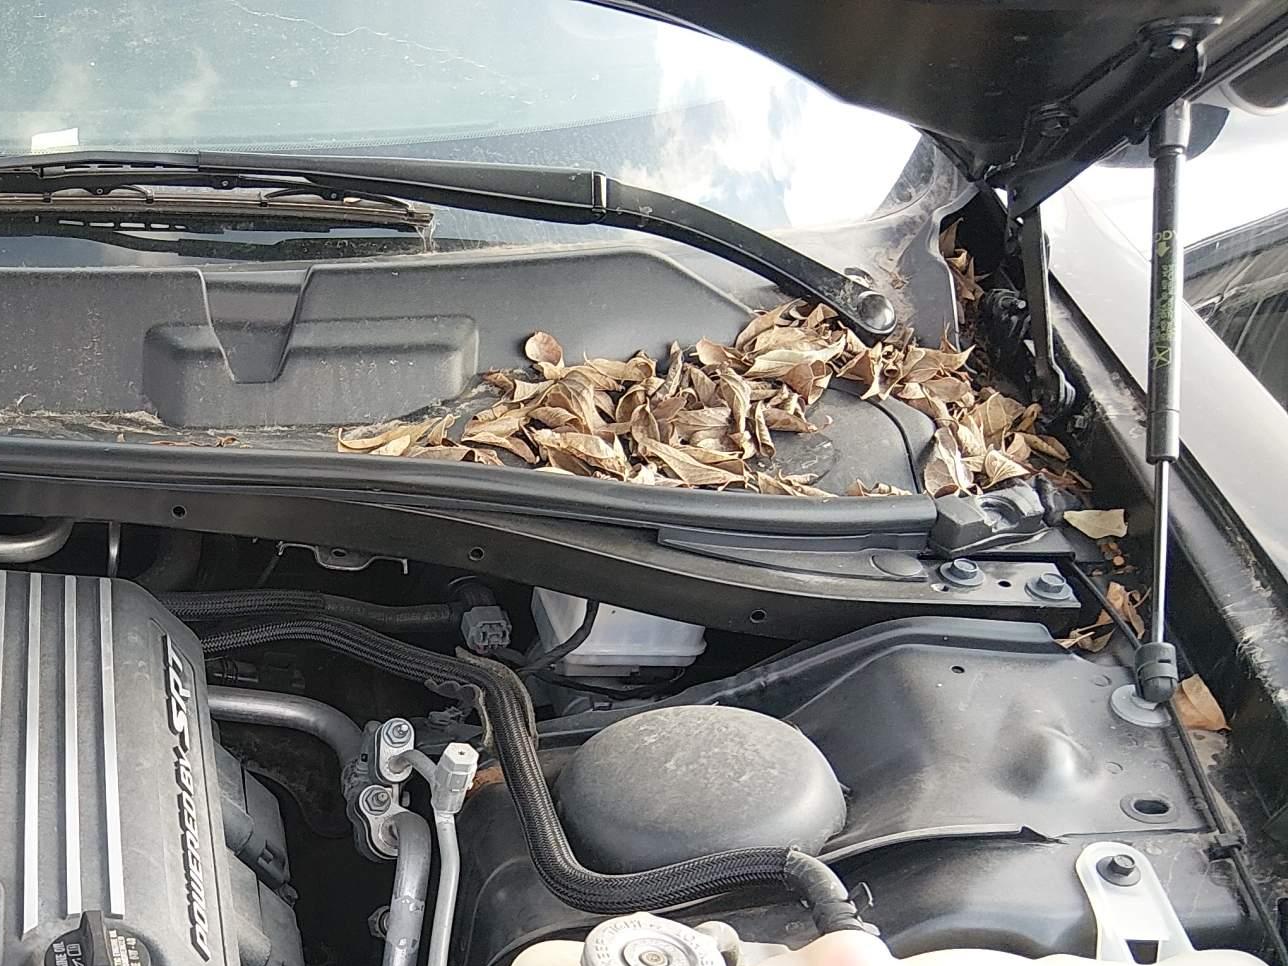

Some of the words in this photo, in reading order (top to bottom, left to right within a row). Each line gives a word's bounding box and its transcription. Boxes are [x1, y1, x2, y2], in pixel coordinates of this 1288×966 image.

[163, 633, 191, 752] SRT
[173, 746, 194, 796] BY
[179, 793, 210, 962] POWERED
[52, 941, 66, 953] OIL
